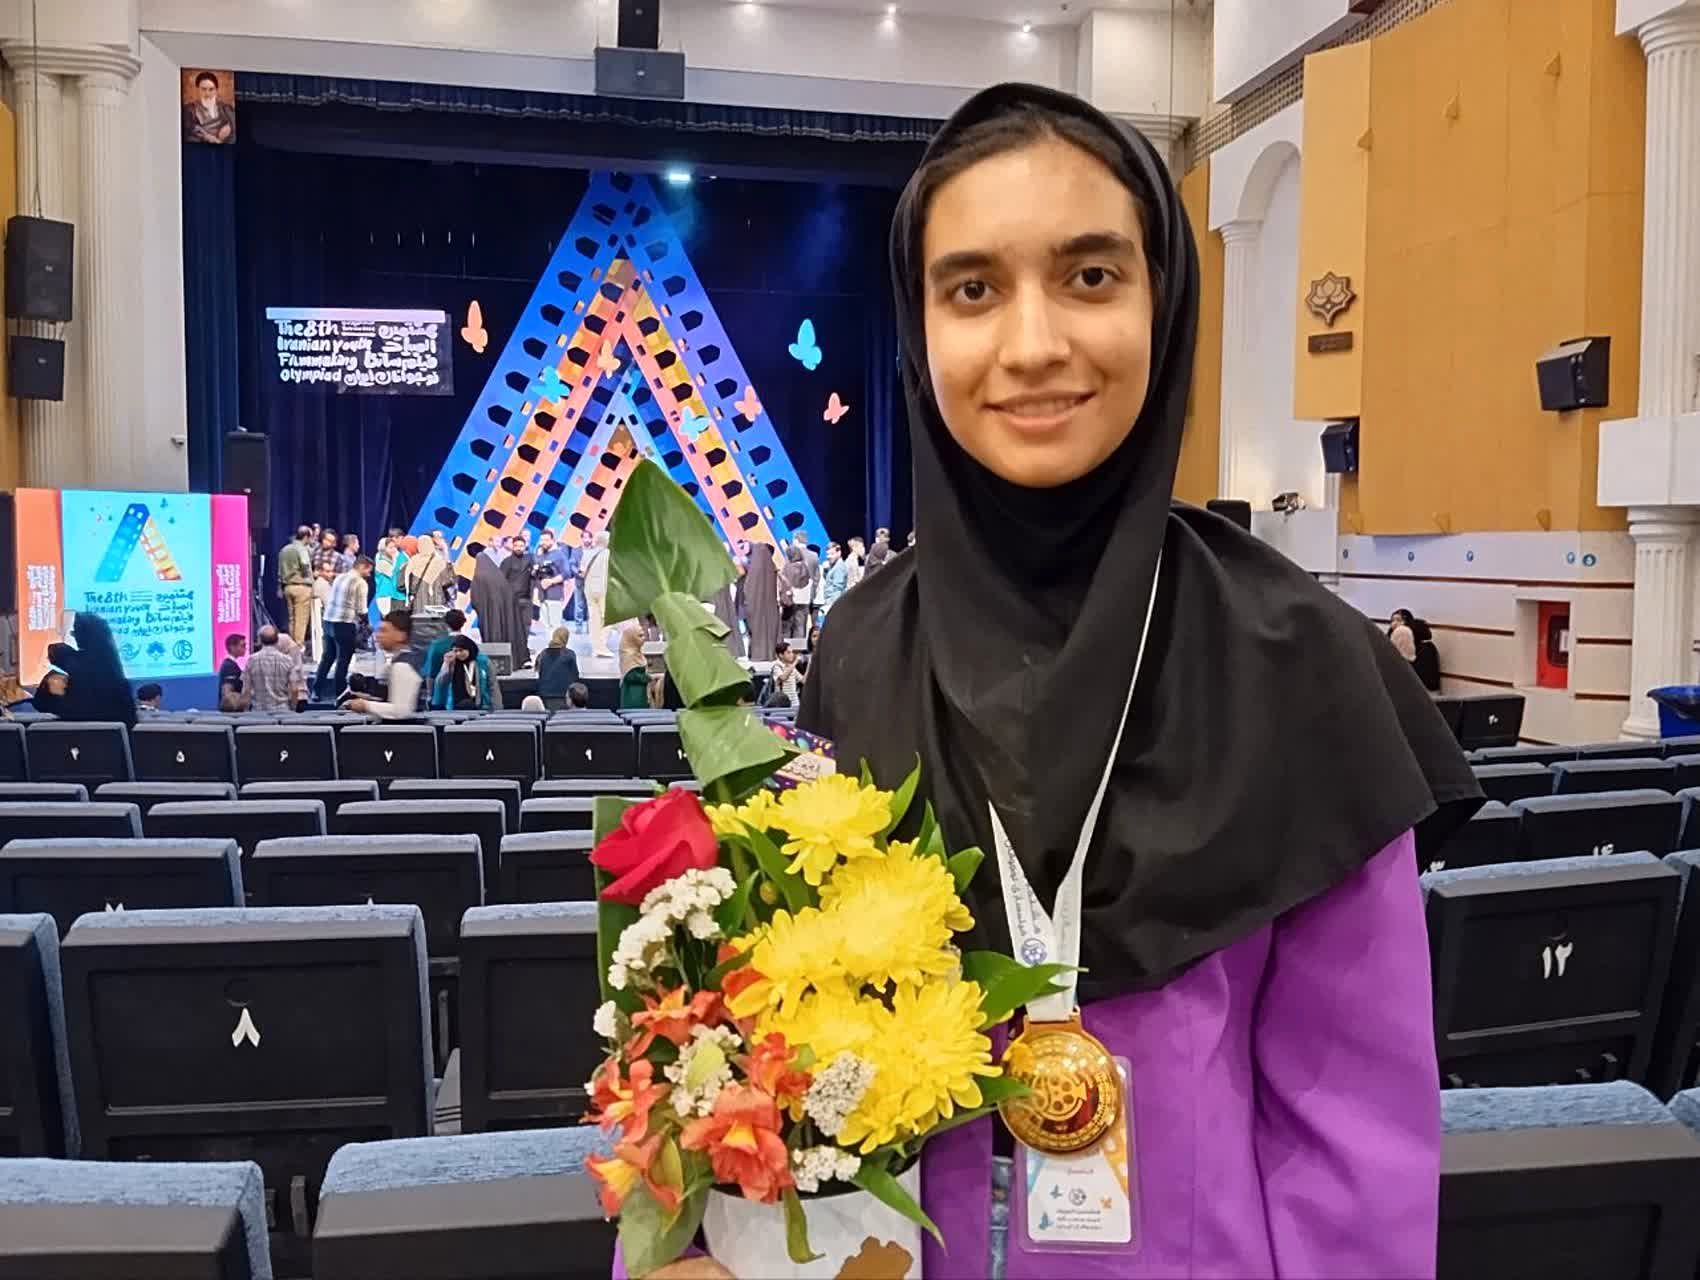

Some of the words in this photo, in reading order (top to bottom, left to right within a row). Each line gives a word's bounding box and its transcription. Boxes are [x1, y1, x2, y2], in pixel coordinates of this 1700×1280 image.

[275, 320, 303, 336] The
[303, 320, 339, 336] 8th
[277, 336, 330, 351] Iranian
[280, 369, 342, 384] Olympiad
[384, 750, 393, 762] ۷
[485, 749, 495, 761] ۸
[584, 749, 593, 761] ۹
[1542, 942, 1573, 979] ۱۲
[231, 1008, 261, 1048] ۸
